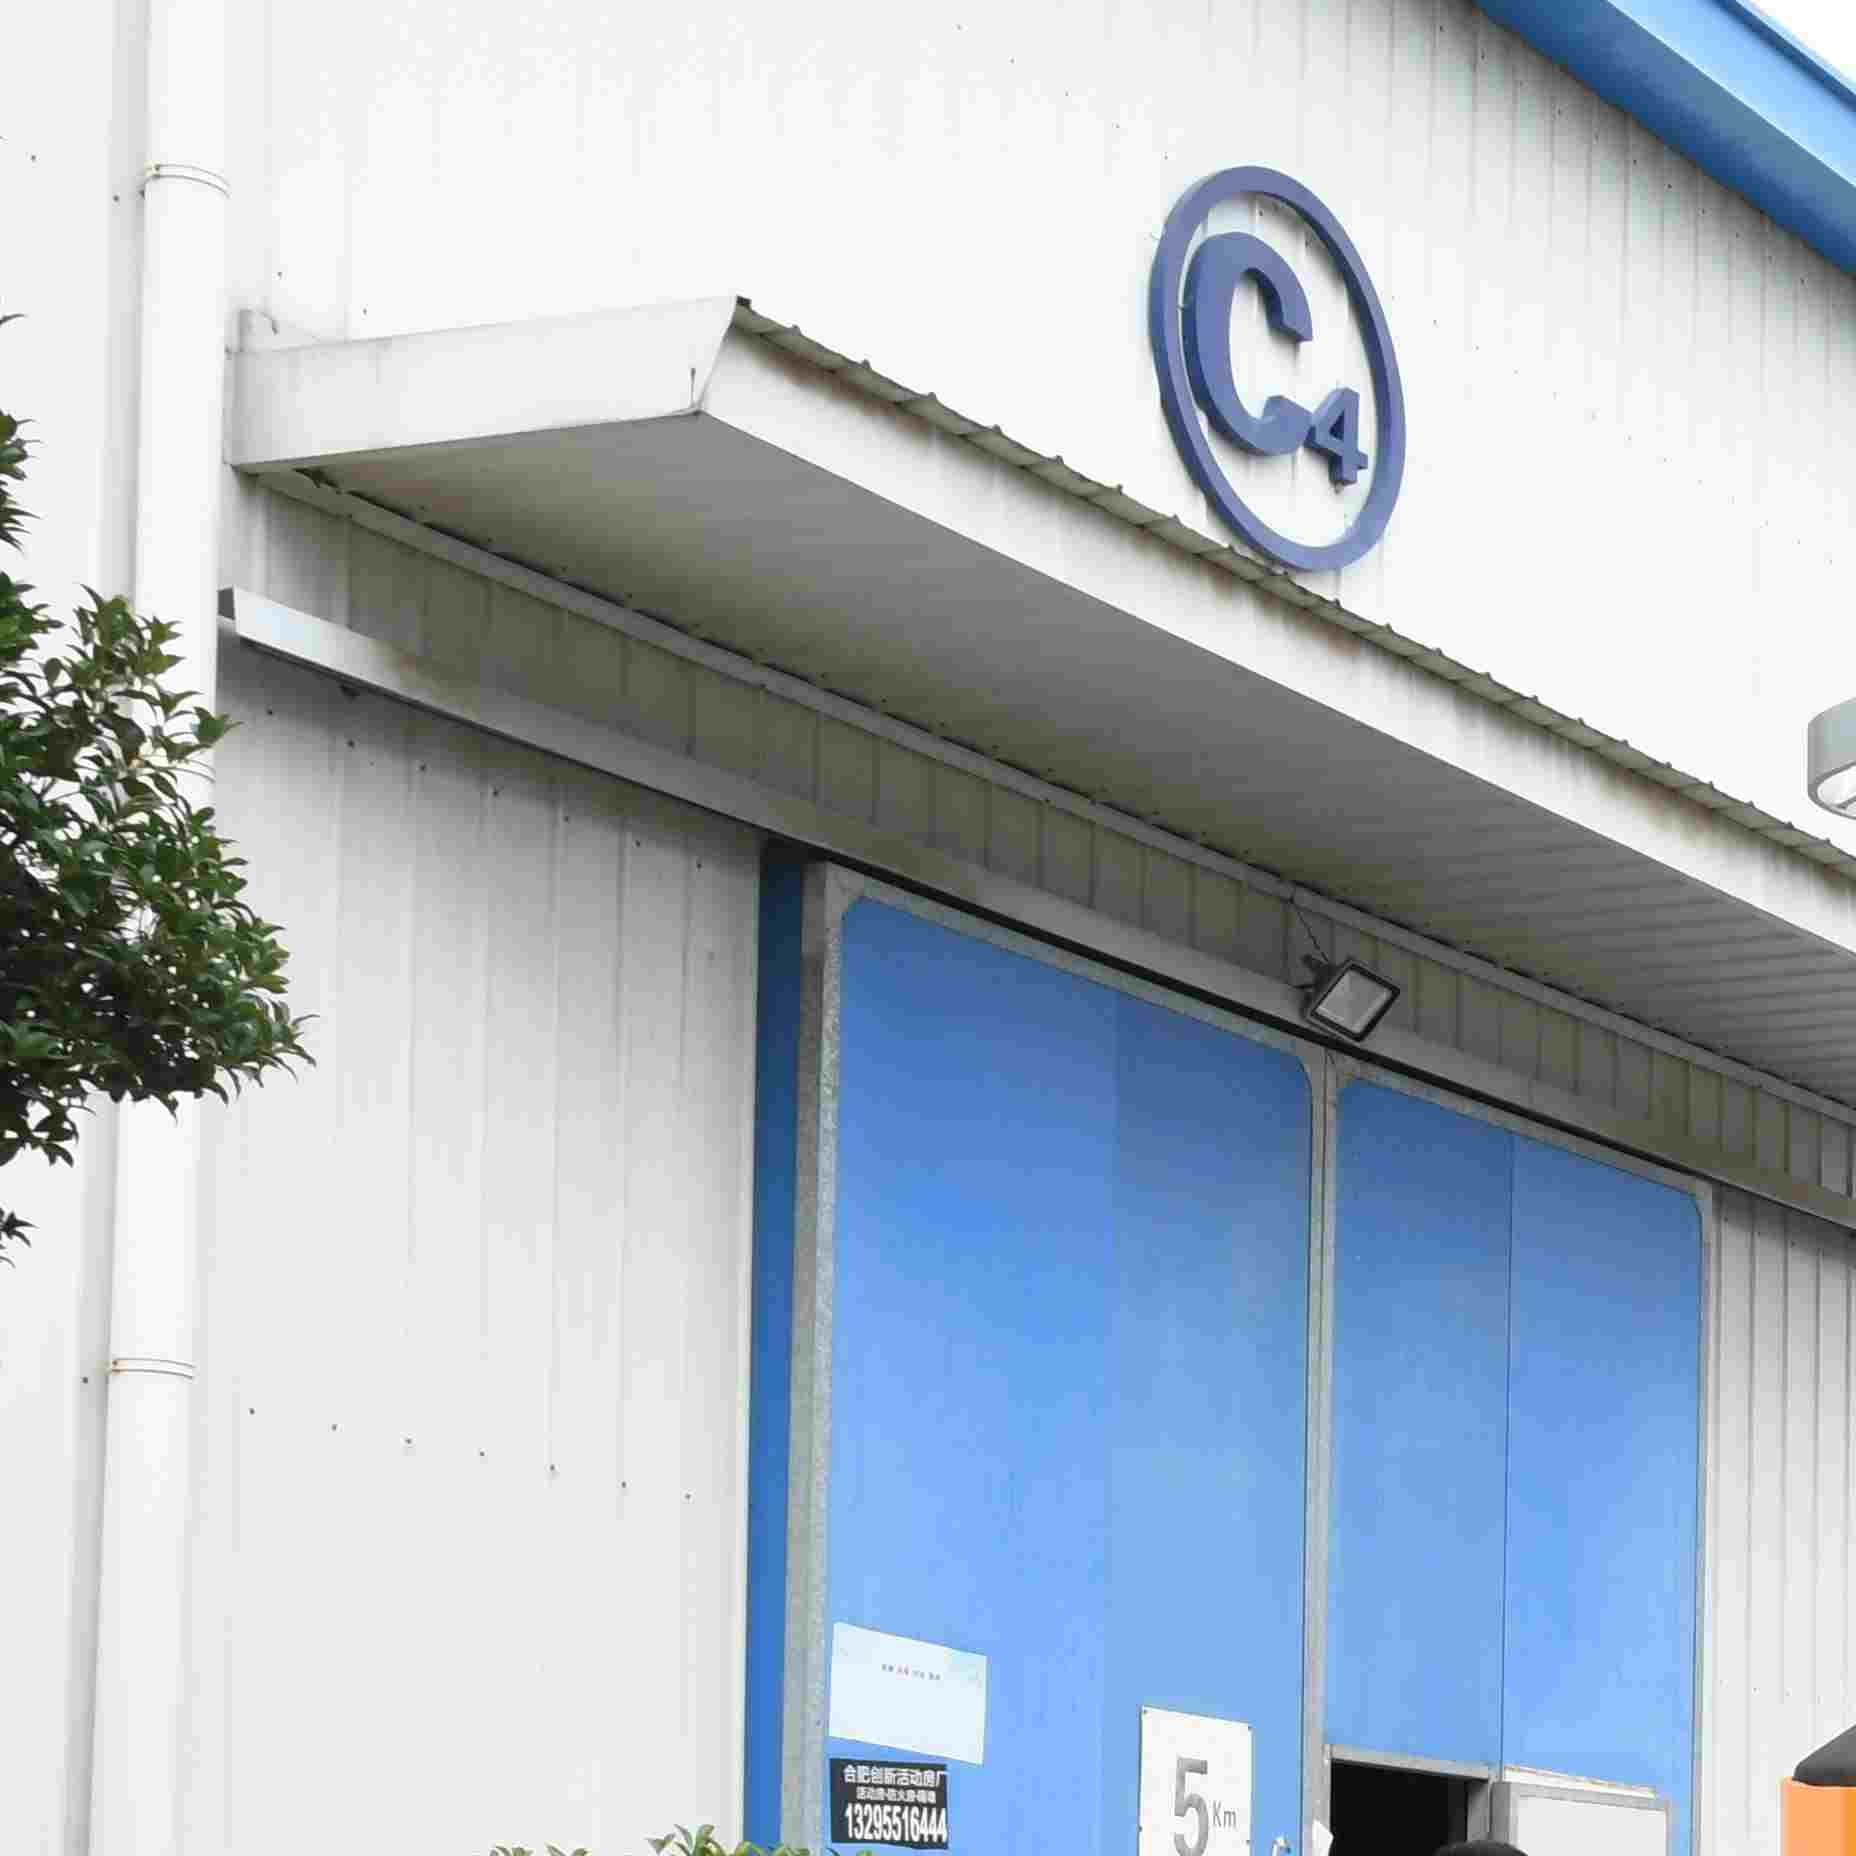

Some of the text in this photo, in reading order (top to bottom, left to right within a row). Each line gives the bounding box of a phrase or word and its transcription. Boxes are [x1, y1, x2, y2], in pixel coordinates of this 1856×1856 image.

[1180, 231, 1368, 486] C4
[845, 1803, 948, 1843] 13295516444
[1212, 1801, 1237, 1829] Km
